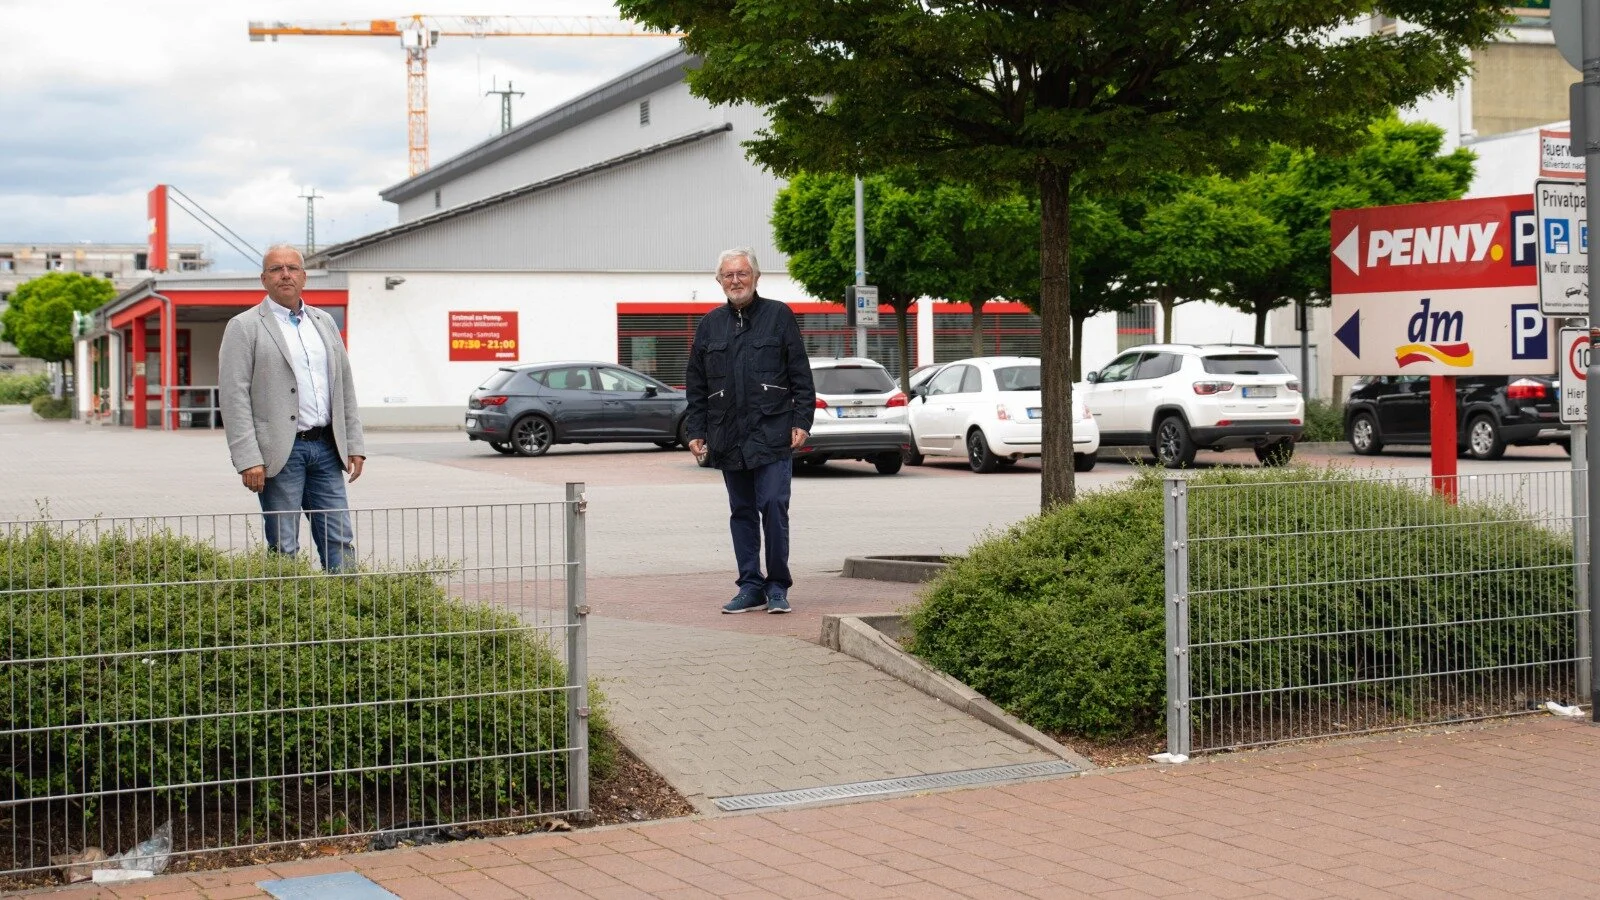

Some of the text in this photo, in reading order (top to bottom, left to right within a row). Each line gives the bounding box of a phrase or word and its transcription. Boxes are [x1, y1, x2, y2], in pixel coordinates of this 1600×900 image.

[1545, 261, 1557, 273] Nur
[1560, 261, 1570, 273] für
[1408, 298, 1463, 343] dm
[1516, 309, 1543, 355] P
[452, 340, 480, 349] 07:30
[487, 340, 515, 349] 21:00
[1567, 388, 1585, 399] Hier
[1567, 405, 1580, 416] die
